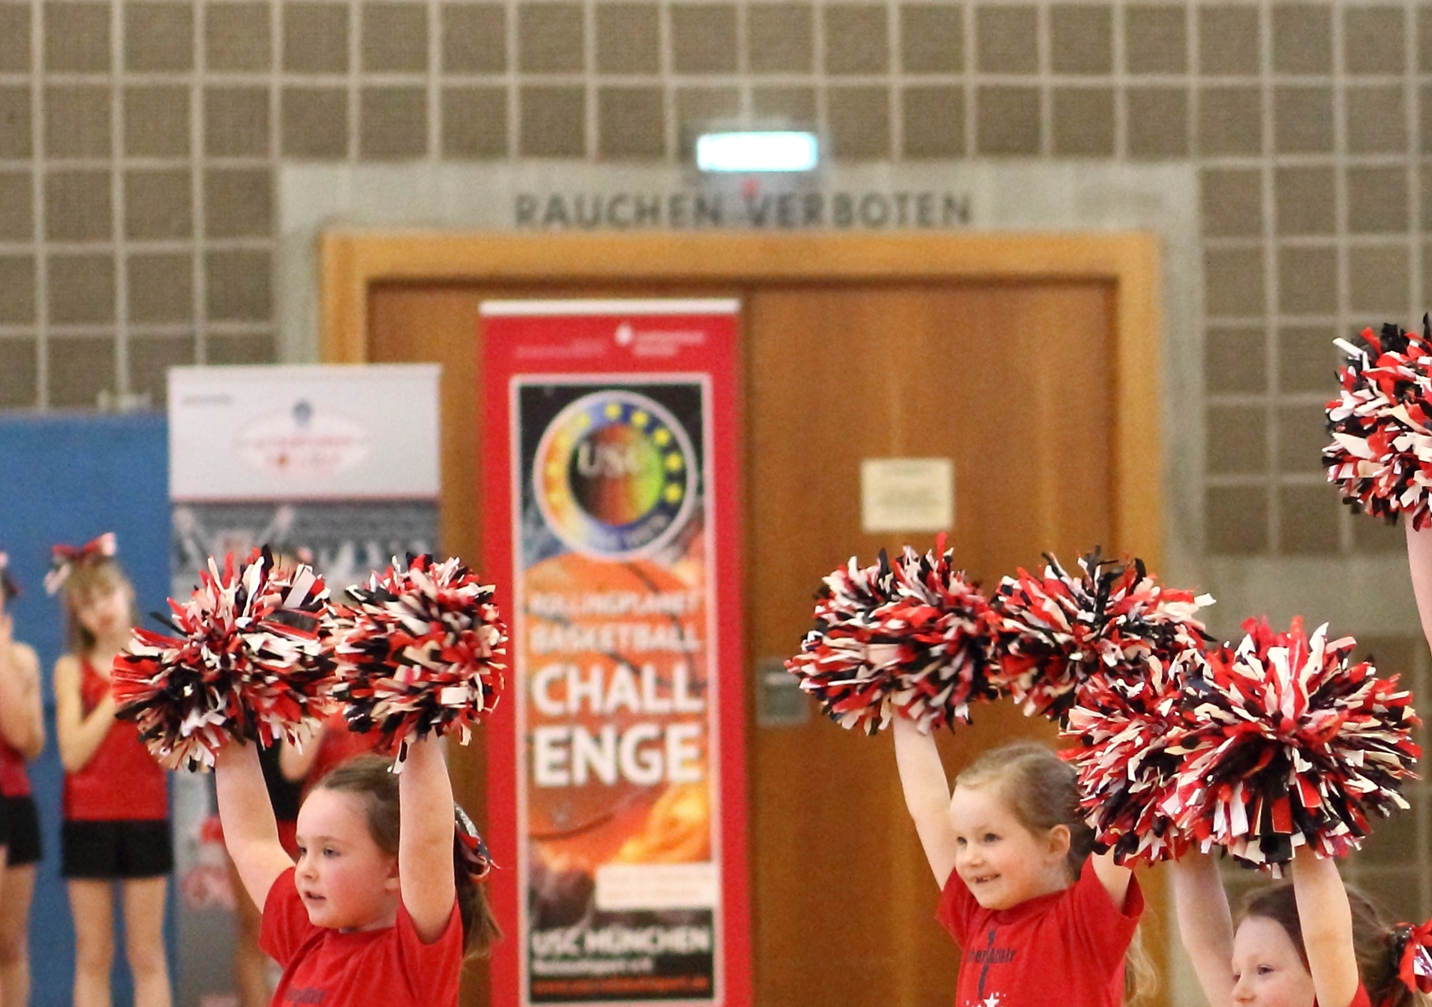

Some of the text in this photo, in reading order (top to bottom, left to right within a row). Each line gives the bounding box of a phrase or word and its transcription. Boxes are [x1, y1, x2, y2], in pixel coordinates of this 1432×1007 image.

[514, 194, 974, 229] RAUCHEN VERBOTEN
[530, 622, 700, 654] BASKETBALL
[531, 662, 704, 716] CHALL
[533, 722, 702, 788] ENGE
